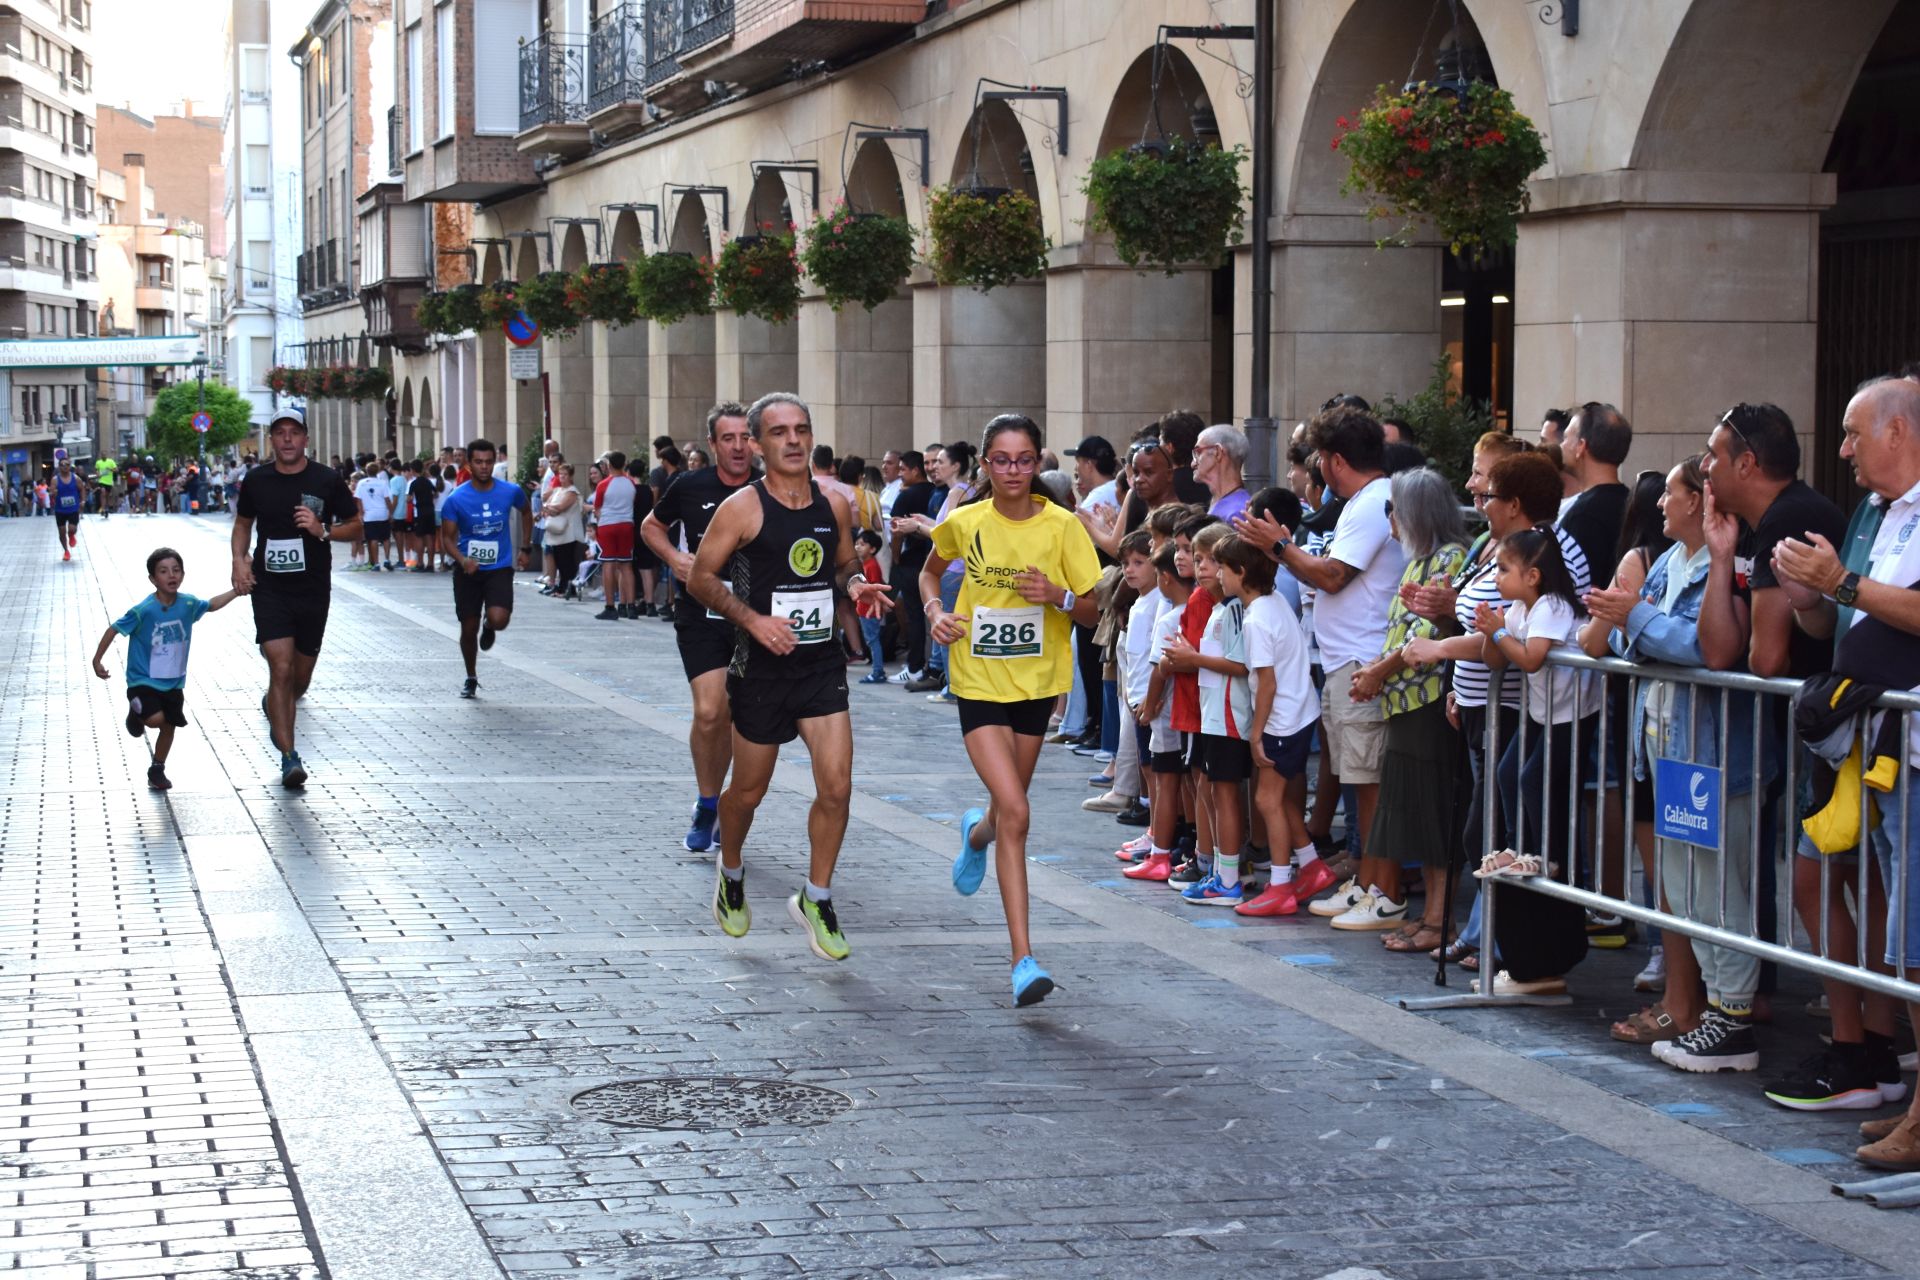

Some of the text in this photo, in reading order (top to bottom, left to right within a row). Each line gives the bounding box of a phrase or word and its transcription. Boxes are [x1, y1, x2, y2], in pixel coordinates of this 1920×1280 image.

[0, 355, 44, 365] ERMOSA
[69, 354, 112, 364] MUNDO
[115, 353, 157, 363] ENTERO
[267, 549, 300, 564] 250
[471, 547, 495, 558] 280
[788, 607, 822, 630] 64
[978, 622, 1036, 645] 286
[1664, 804, 1708, 831] Calahorra
